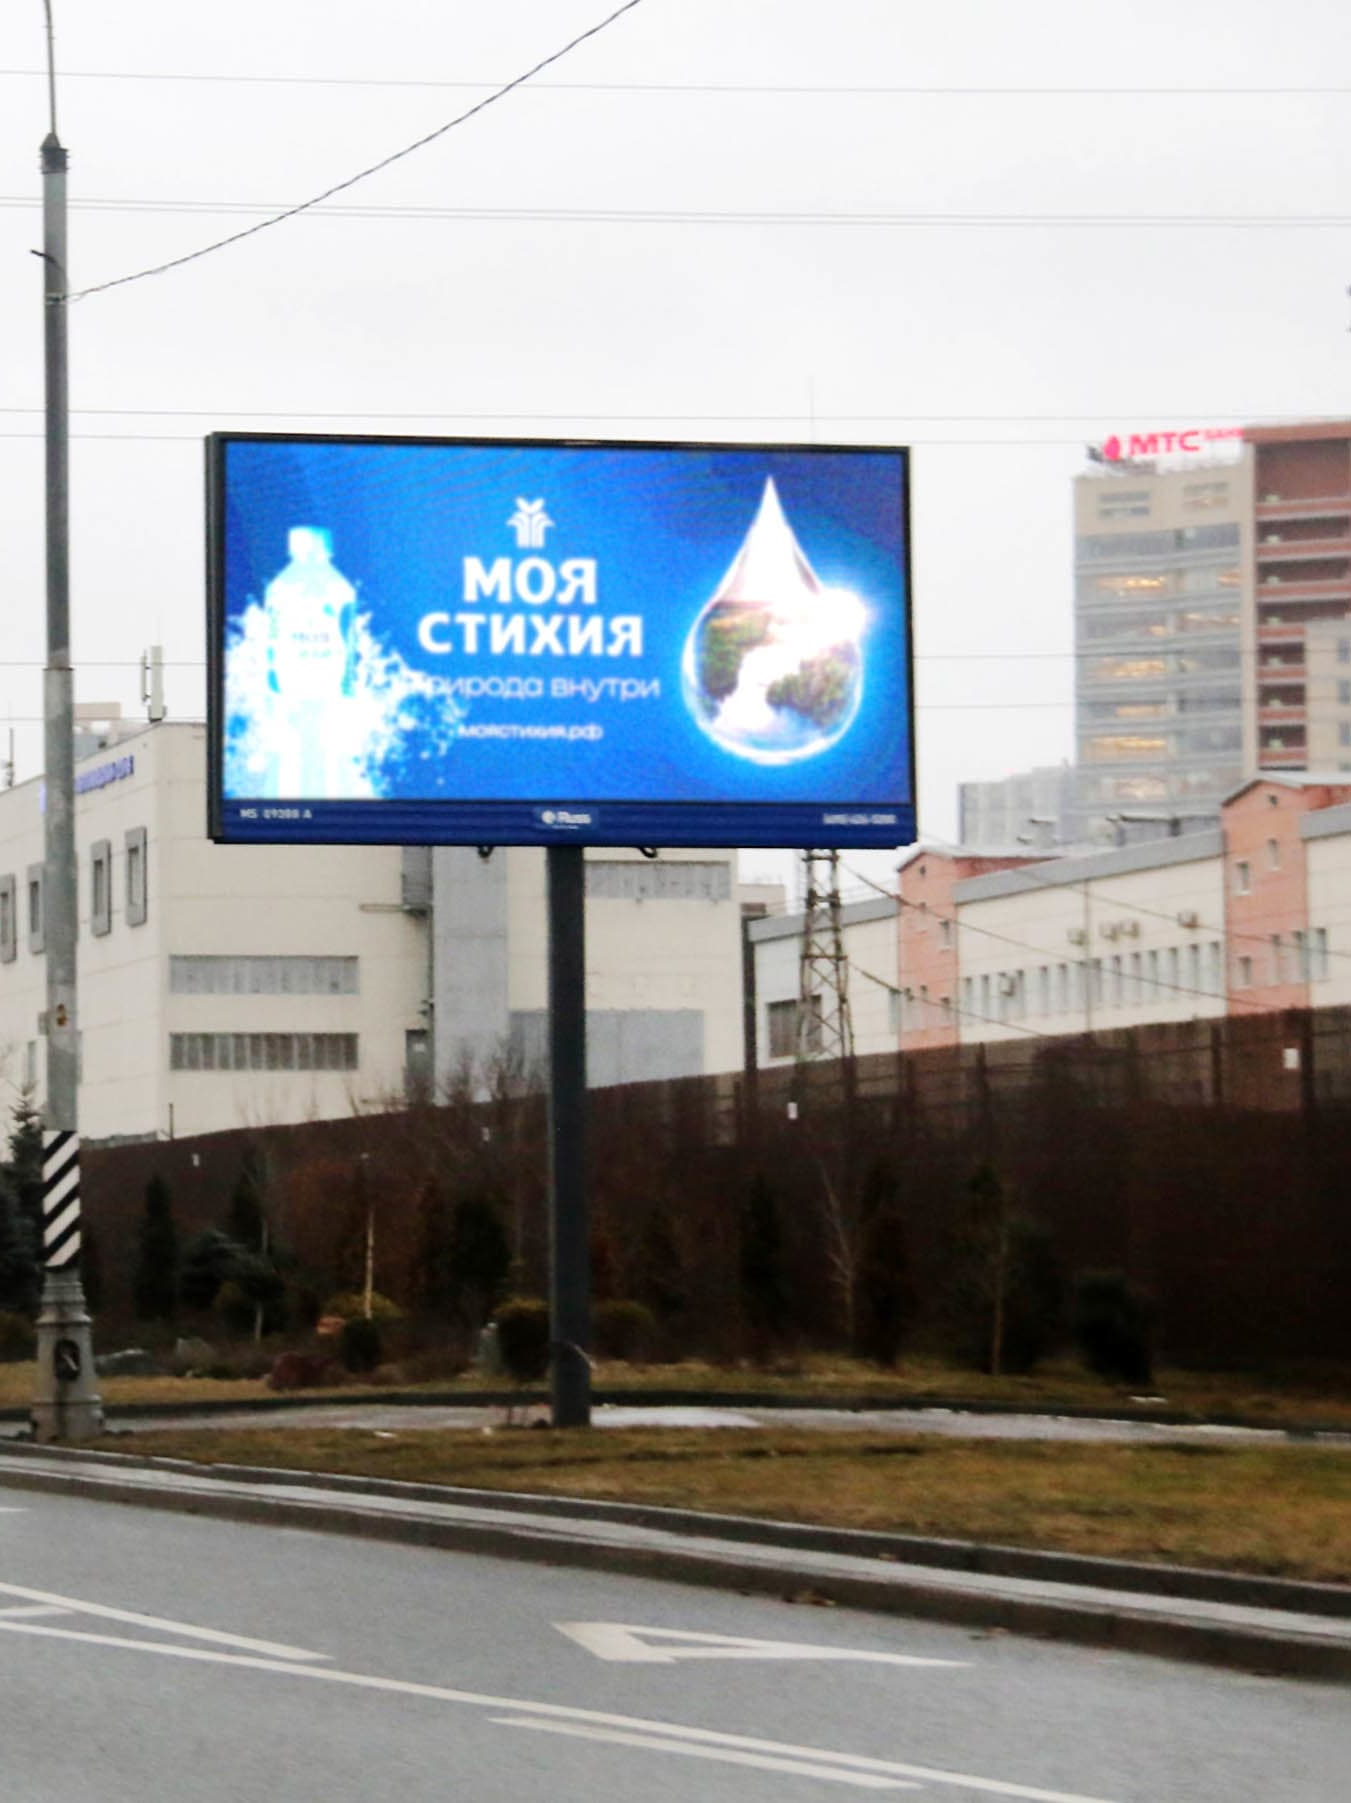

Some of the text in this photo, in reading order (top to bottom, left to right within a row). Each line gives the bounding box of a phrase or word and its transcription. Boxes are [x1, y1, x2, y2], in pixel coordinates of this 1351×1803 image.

[1128, 430, 1200, 456] МТС
[462, 556, 597, 605] МОЯ
[417, 611, 644, 657] СТИХИЯ
[404, 676, 661, 702] рирода внутри
